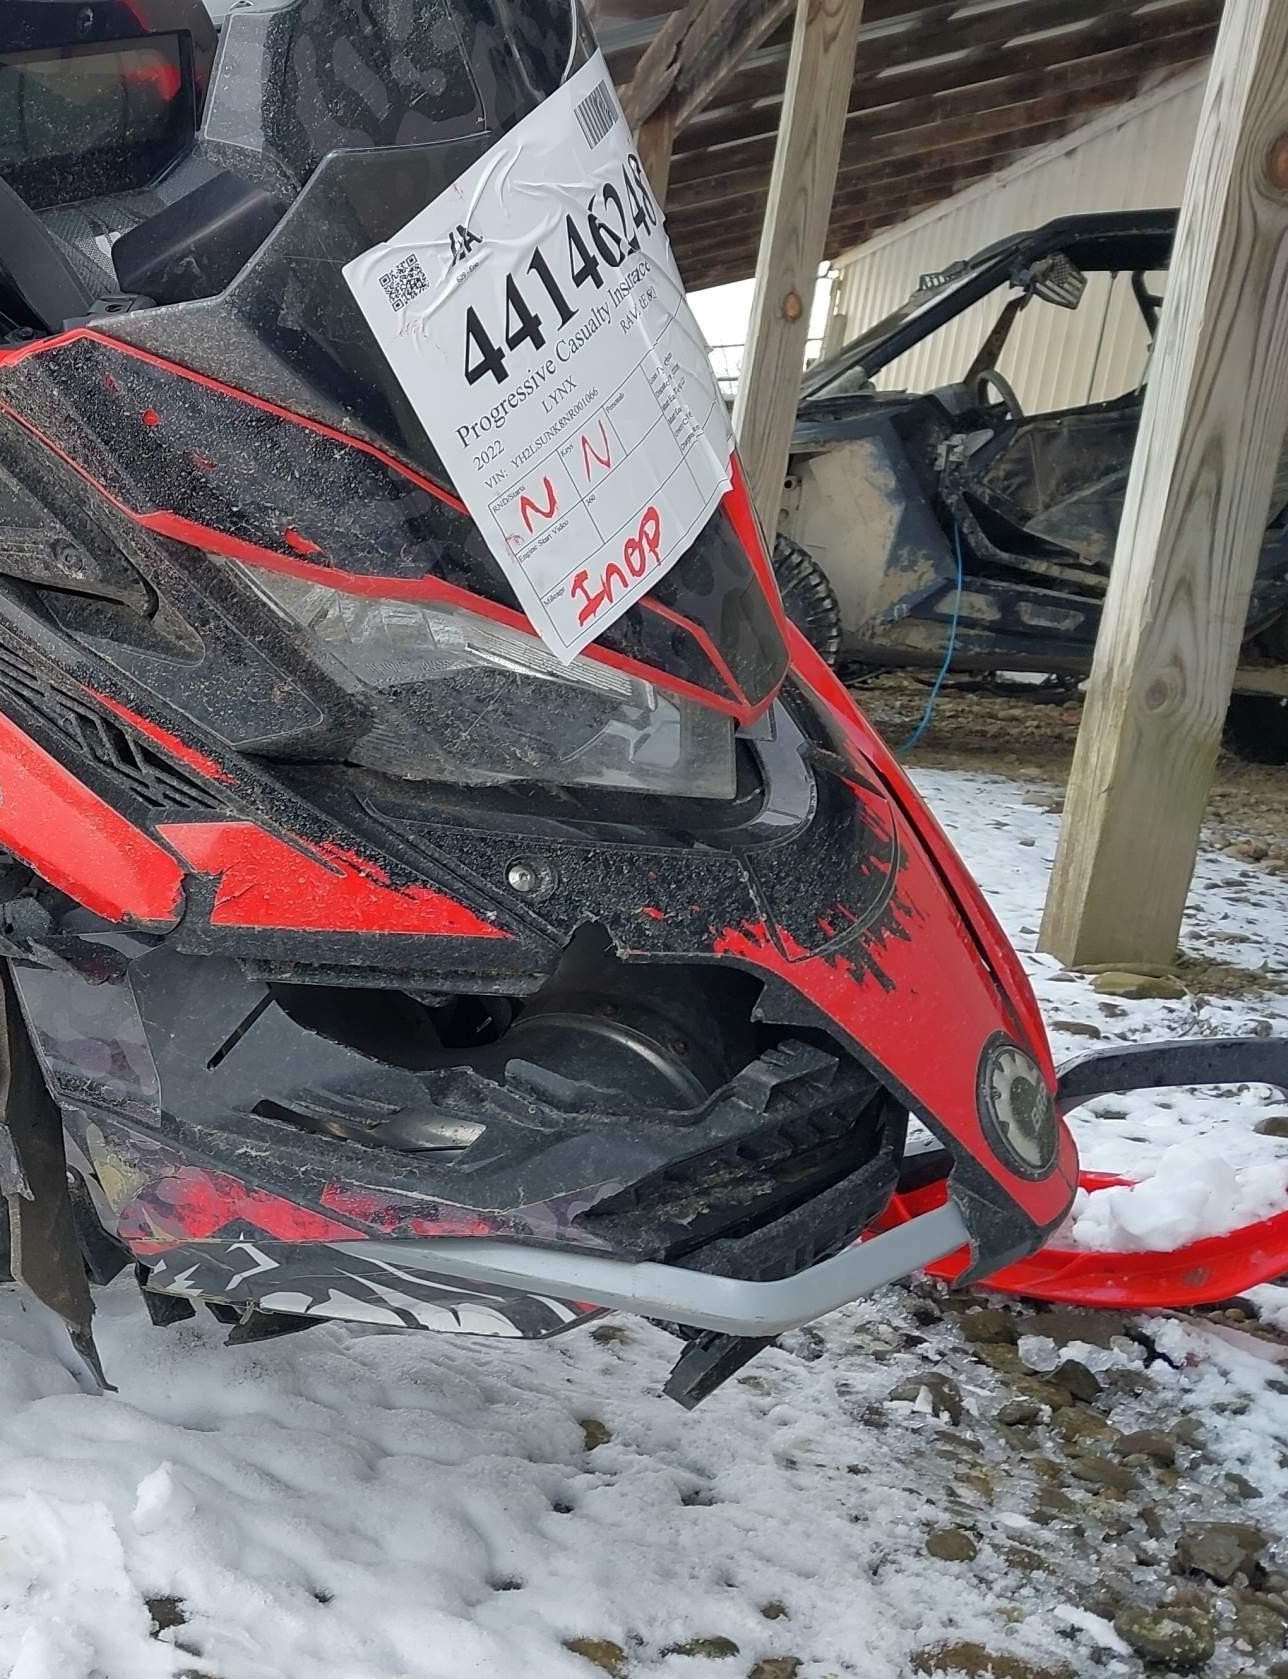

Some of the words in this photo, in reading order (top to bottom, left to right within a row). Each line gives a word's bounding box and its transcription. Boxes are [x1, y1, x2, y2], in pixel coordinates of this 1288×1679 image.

[464, 153, 656, 386] 44146248
[455, 359, 557, 449] Progressive
[556, 302, 612, 362] Casualty
[473, 440, 505, 471] 2022
[541, 376, 577, 414] LYNX
[484, 469, 509, 489] VIN:
[511, 387, 599, 469] YH2LSUNK8NR001066
[560, 444, 575, 457] Keys
[581, 420, 611, 482] N
[492, 485, 526, 513] RND/Starts
[520, 476, 557, 534] N
[518, 544, 538, 563] Engine
[538, 533, 553, 547] Start
[552, 520, 569, 536] Video
[543, 587, 566, 607] Mileage
